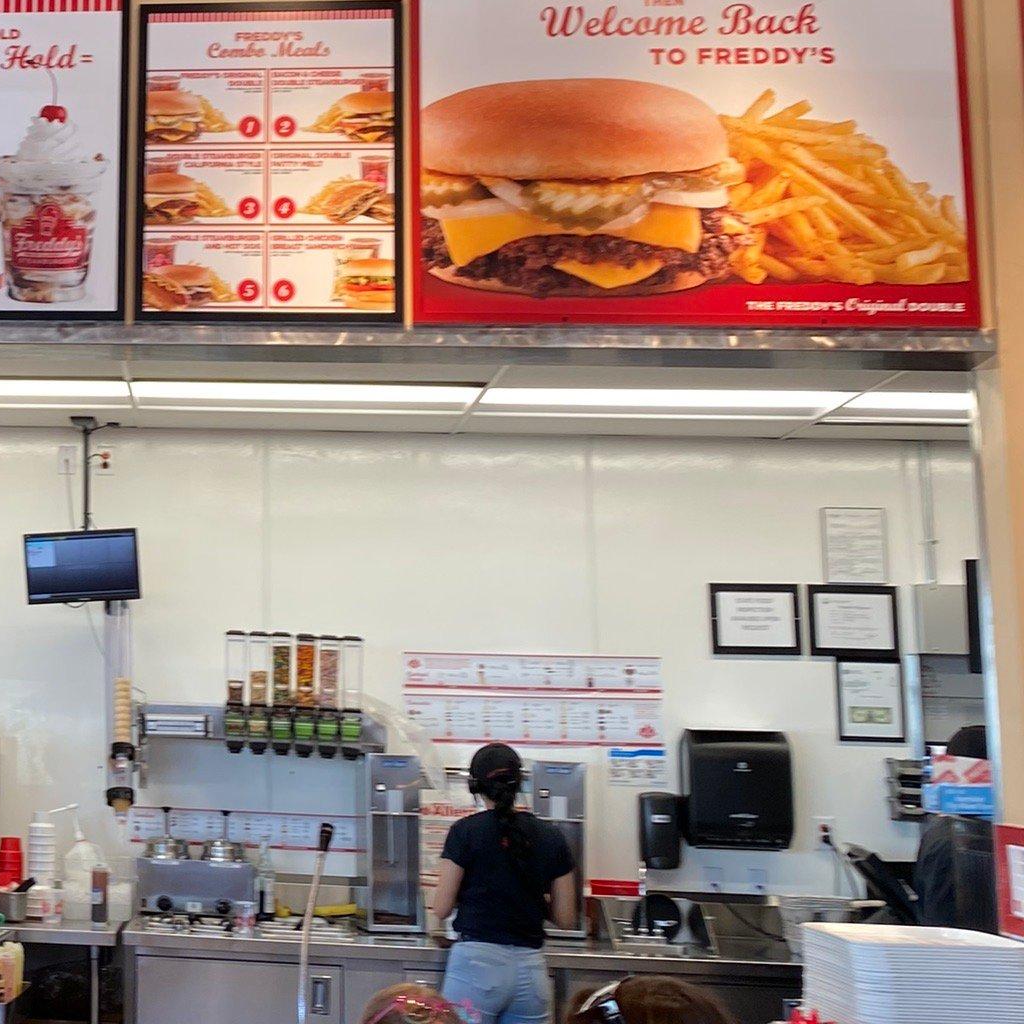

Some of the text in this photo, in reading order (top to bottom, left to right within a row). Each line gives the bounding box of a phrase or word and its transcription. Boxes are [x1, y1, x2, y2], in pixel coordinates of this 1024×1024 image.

[539, 2, 820, 37] Welcome Back
[235, 31, 303, 41] FREDDY'S
[0, 43, 78, 70] Hold
[649, 47, 836, 65] TO FREDDY'S
[278, 121, 291, 133] 2
[243, 202, 256, 214] 3
[278, 201, 291, 214] 4
[243, 284, 256, 297] 5
[277, 284, 289, 297] 6
[746, 301, 775, 311] THE
[776, 301, 844, 311] FREDDY'S
[907, 302, 966, 312] DOUBLE
